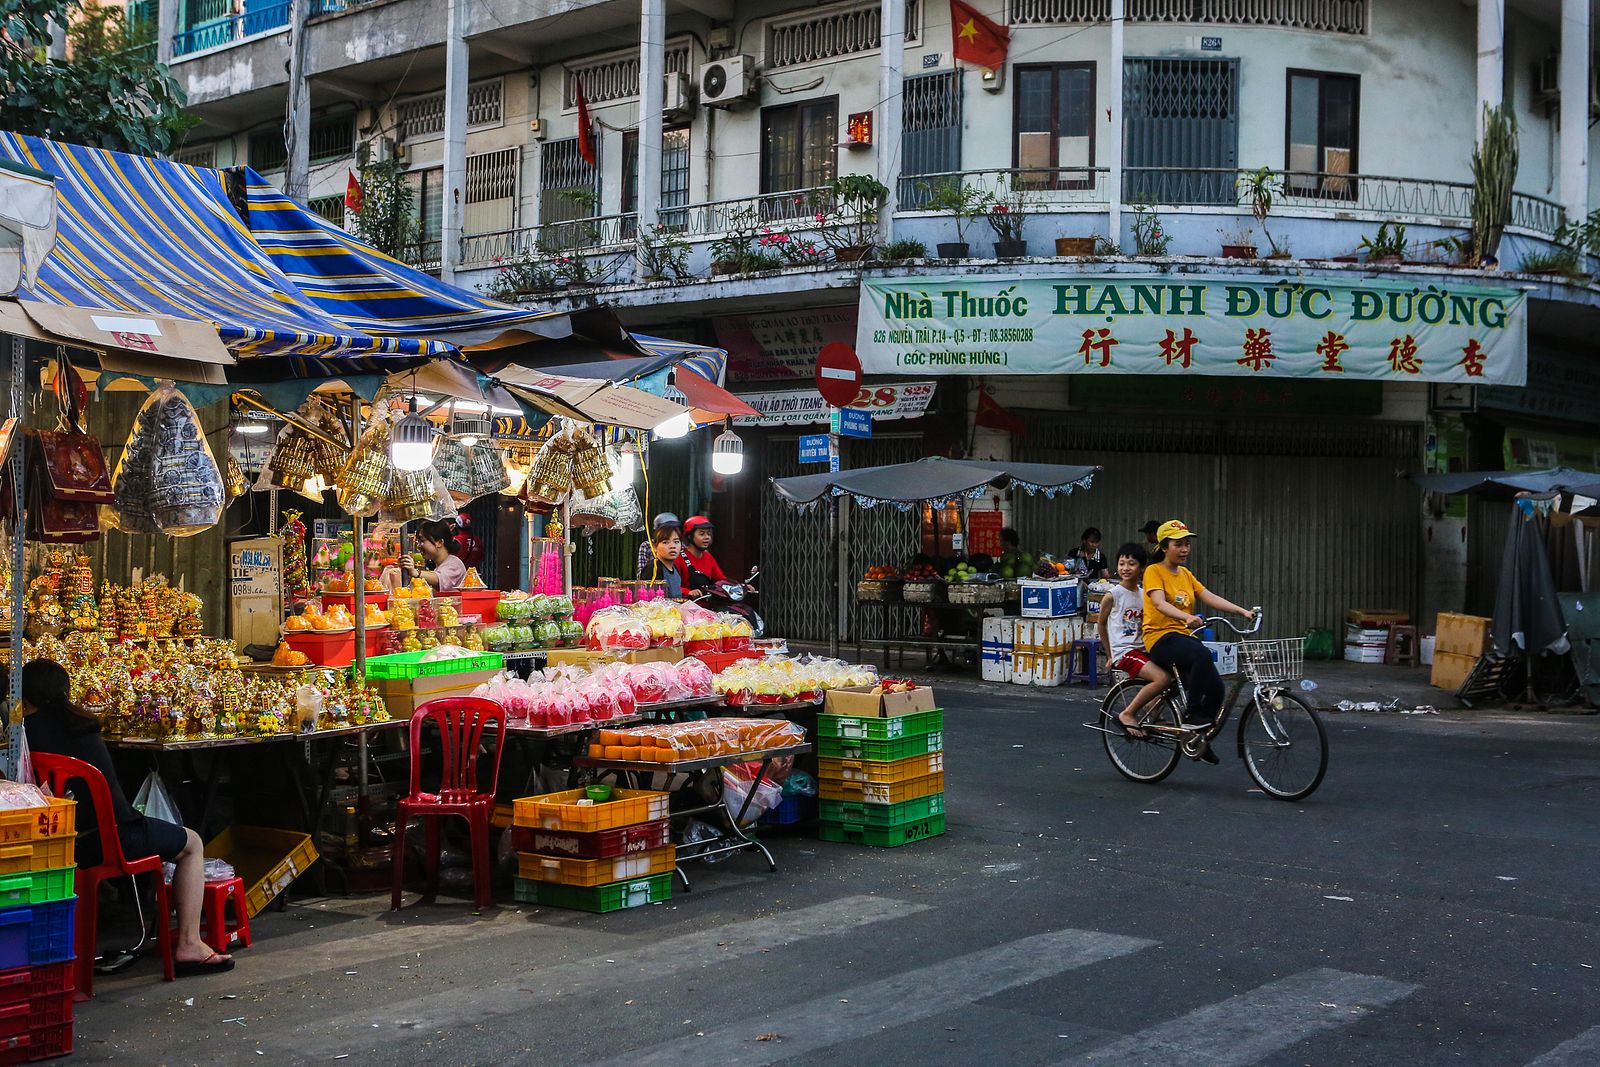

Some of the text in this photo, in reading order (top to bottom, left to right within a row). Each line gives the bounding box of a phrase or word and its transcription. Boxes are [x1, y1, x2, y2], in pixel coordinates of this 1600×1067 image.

[885, 286, 1028, 319] Nhà Thuốc
[1052, 279, 1508, 328] HẠNH ĐỨC ĐƯỜNG
[873, 329, 886, 344] 826
[889, 324, 913, 344] NGUYỄN
[915, 327, 930, 344] TRÃI
[932, 329, 946, 344] P.14
[954, 329, 965, 346] Q.5
[972, 328, 981, 343] ĐT
[989, 328, 1034, 343] 08.38560288
[904, 349, 926, 365] GÓC
[929, 349, 966, 365] PHÙNG
[969, 350, 1001, 365] HƯNG
[846, 387, 897, 408] 28
[903, 385, 931, 396] 828
[768, 397, 780, 411] ÁO
[800, 397, 824, 409] TRANG
